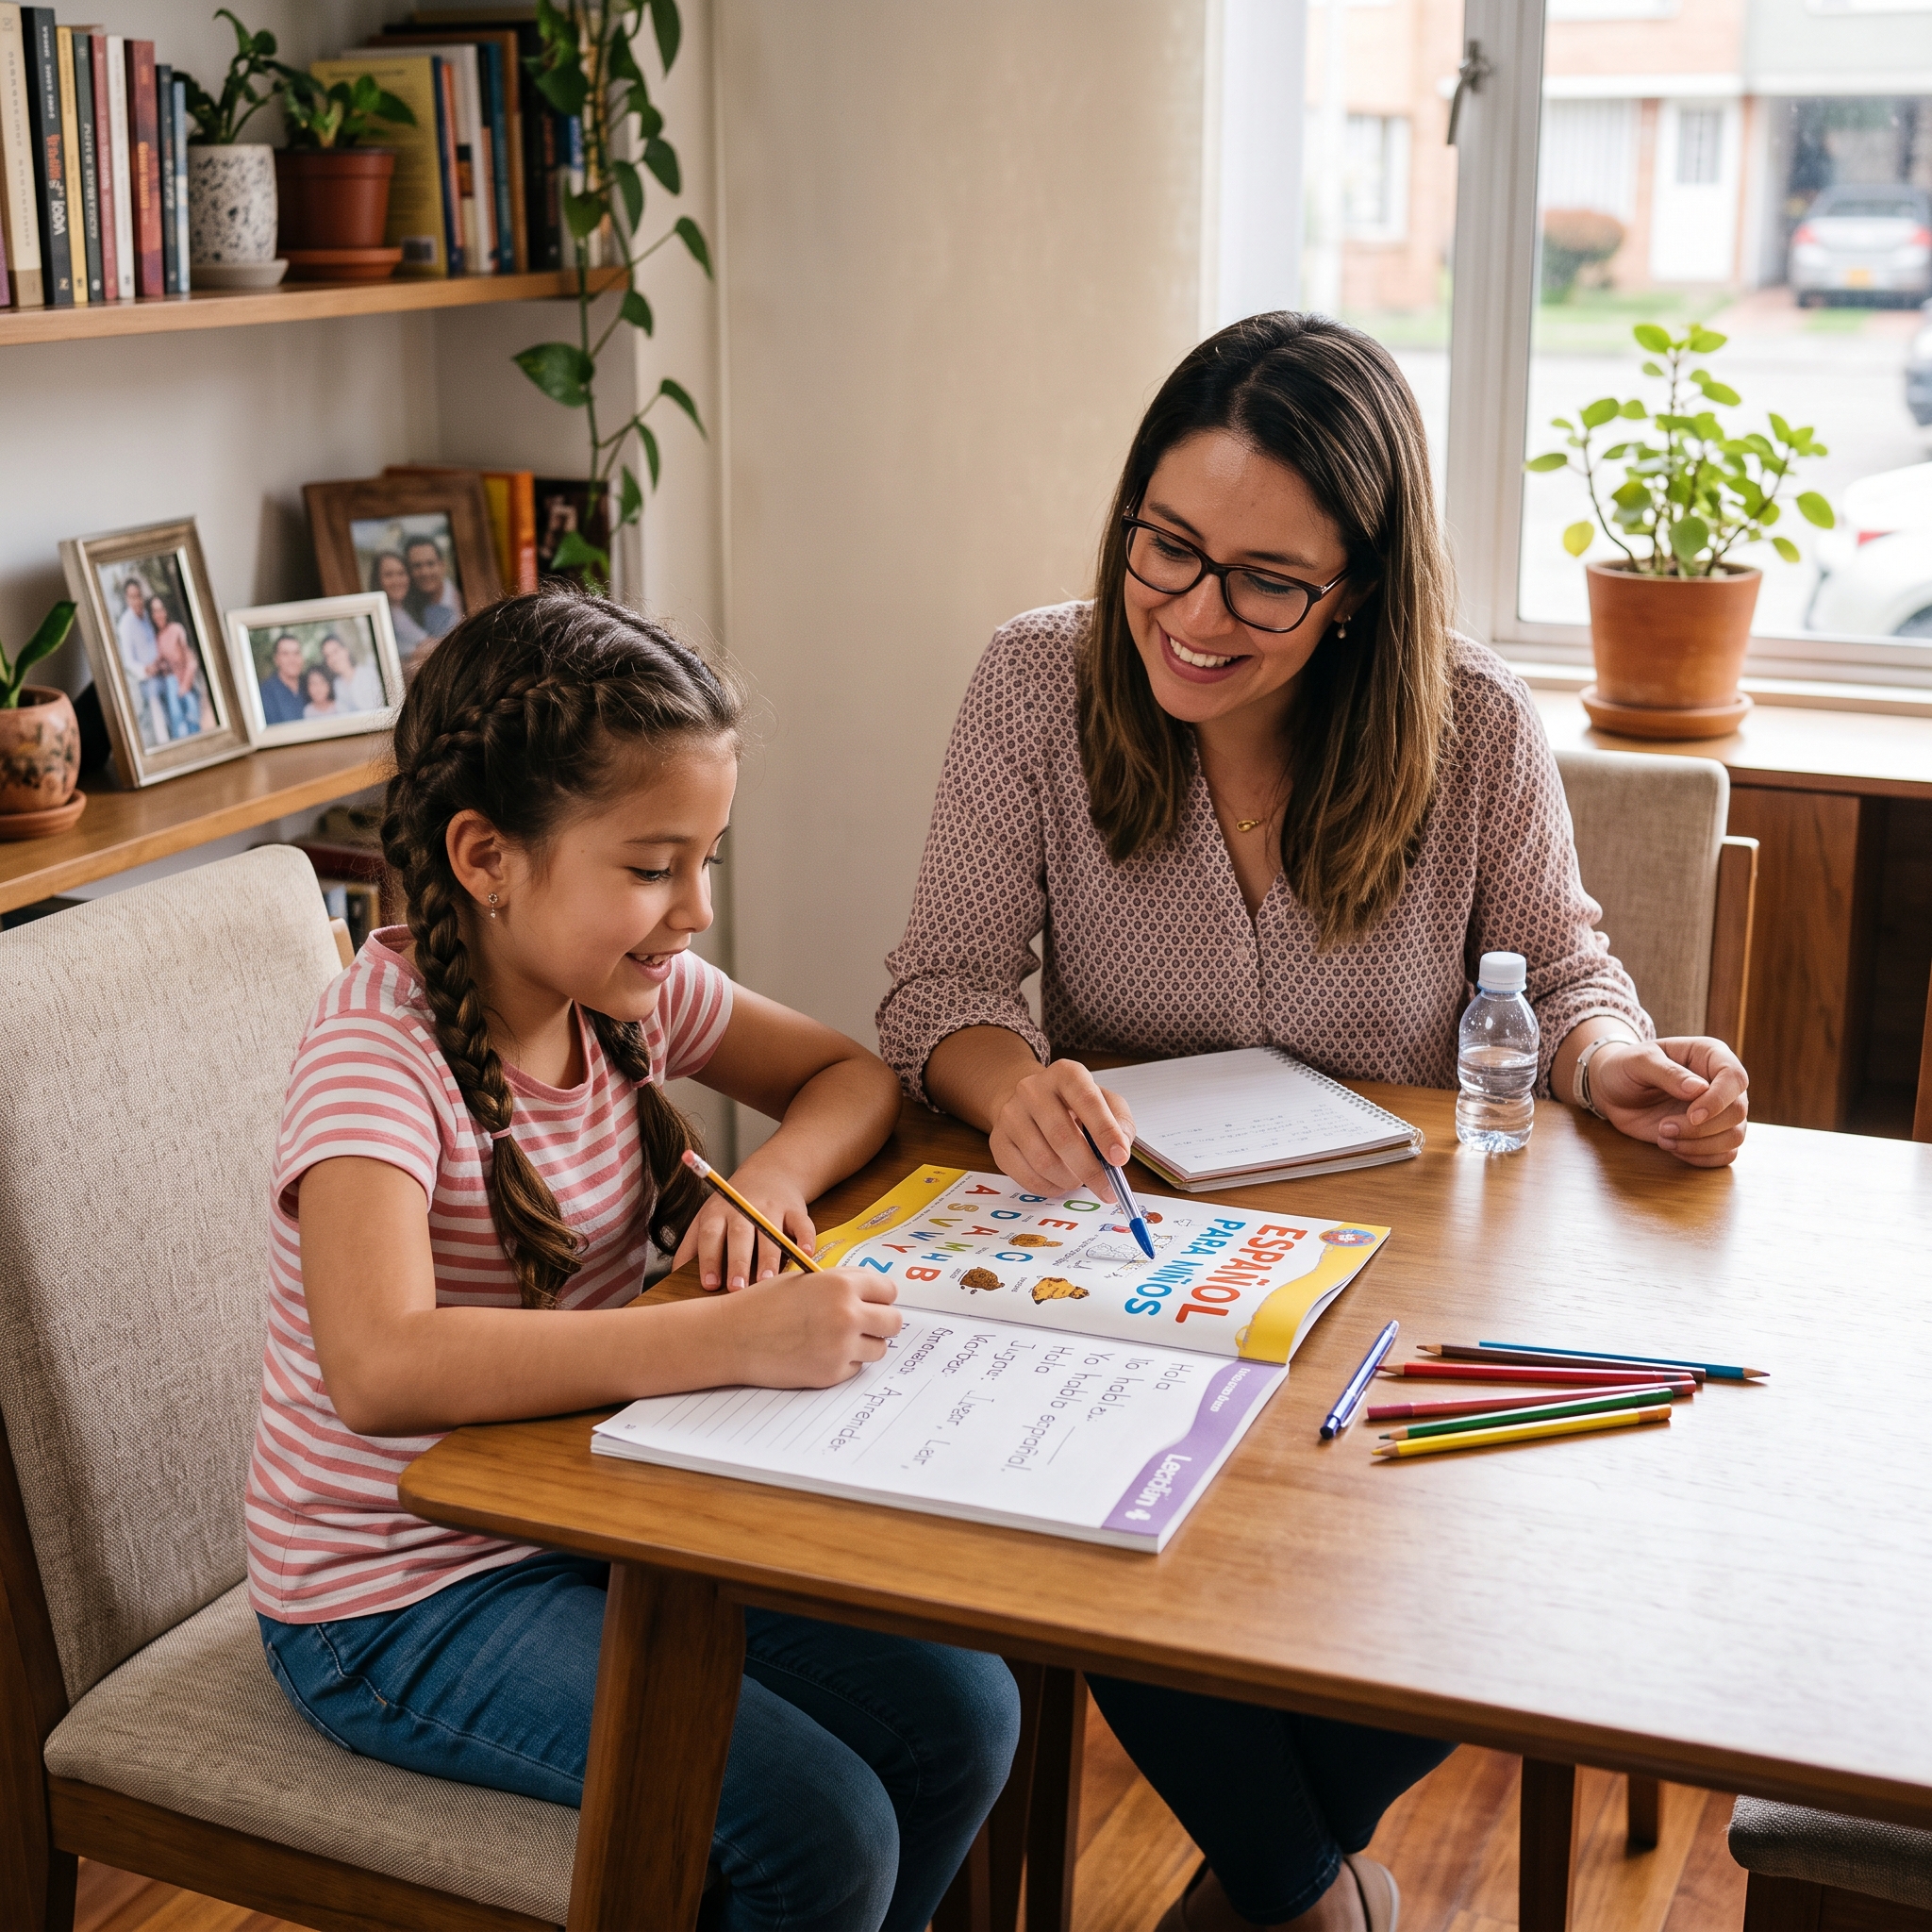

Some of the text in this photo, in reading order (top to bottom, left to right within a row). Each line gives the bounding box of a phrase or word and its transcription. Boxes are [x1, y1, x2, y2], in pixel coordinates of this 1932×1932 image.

[964, 1184, 1002, 1195] A
[947, 1202, 980, 1213] S
[990, 1209, 1023, 1220] D
[928, 1218, 964, 1228] V
[1038, 1218, 1079, 1231] E
[908, 1230, 945, 1241] W
[881, 1243, 917, 1254] Y
[934, 1241, 974, 1253] M
[920, 1252, 954, 1262] H
[858, 1257, 894, 1274] Z
[1124, 1218, 1247, 1316] PARA NIÑOS
[905, 1266, 942, 1282] B
[1174, 1224, 1308, 1324] ESPAÑOL
[1083, 1352, 1115, 1365] Yo
[1155, 1362, 1194, 1391] Hola
[1050, 1373, 1103, 1408] hablo
